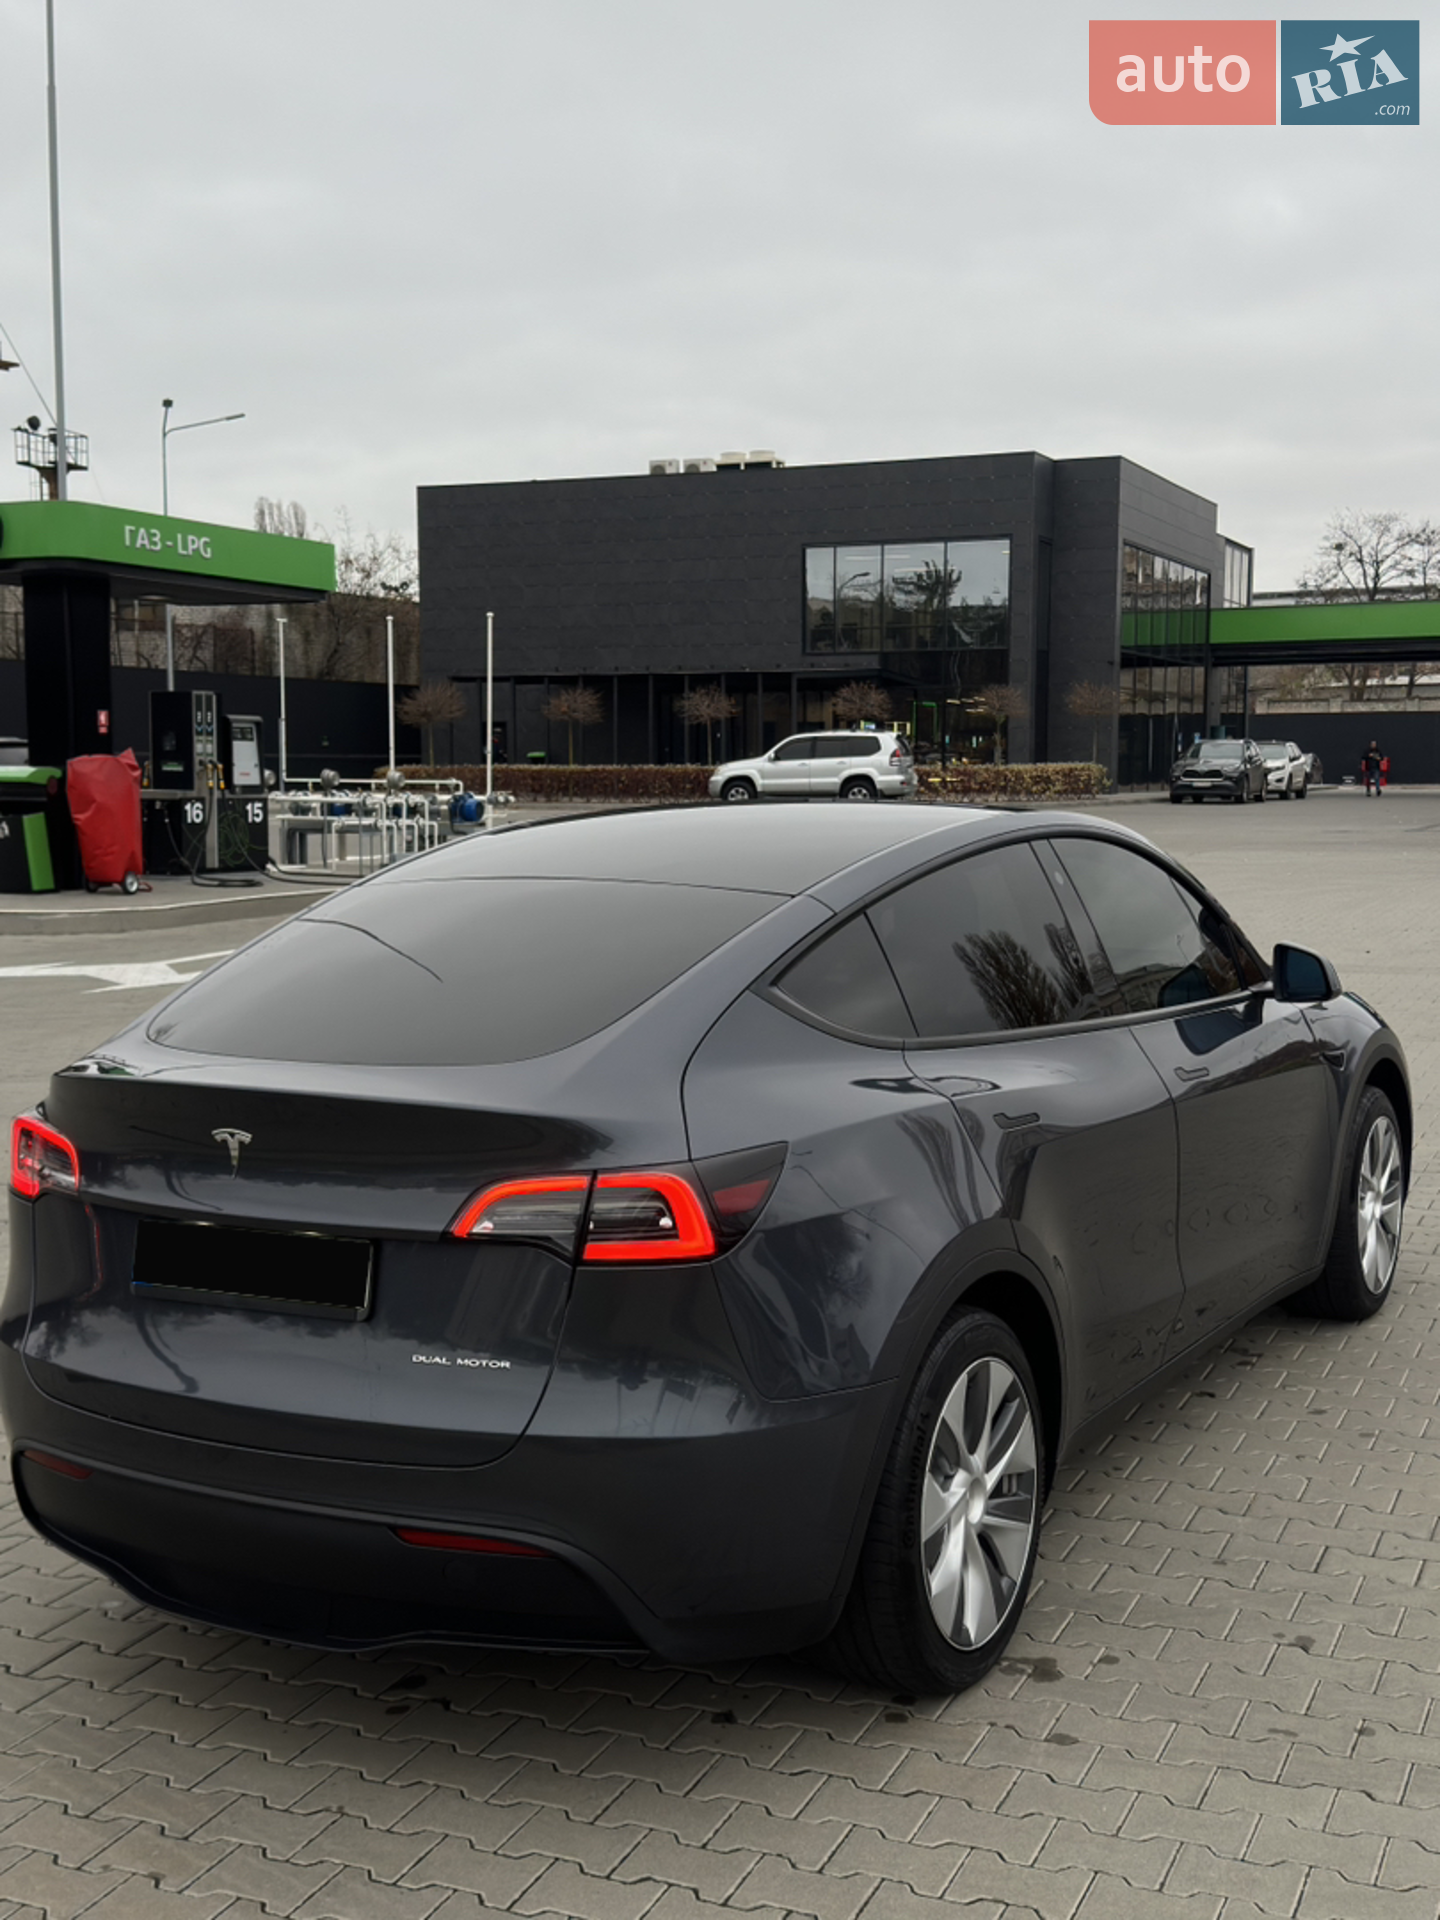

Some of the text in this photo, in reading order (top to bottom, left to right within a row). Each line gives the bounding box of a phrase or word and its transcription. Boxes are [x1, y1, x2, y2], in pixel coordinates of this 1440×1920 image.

[184, 802, 204, 823] 16
[245, 802, 263, 823] 15
[411, 1354, 511, 1369] DUAL MOTOR
